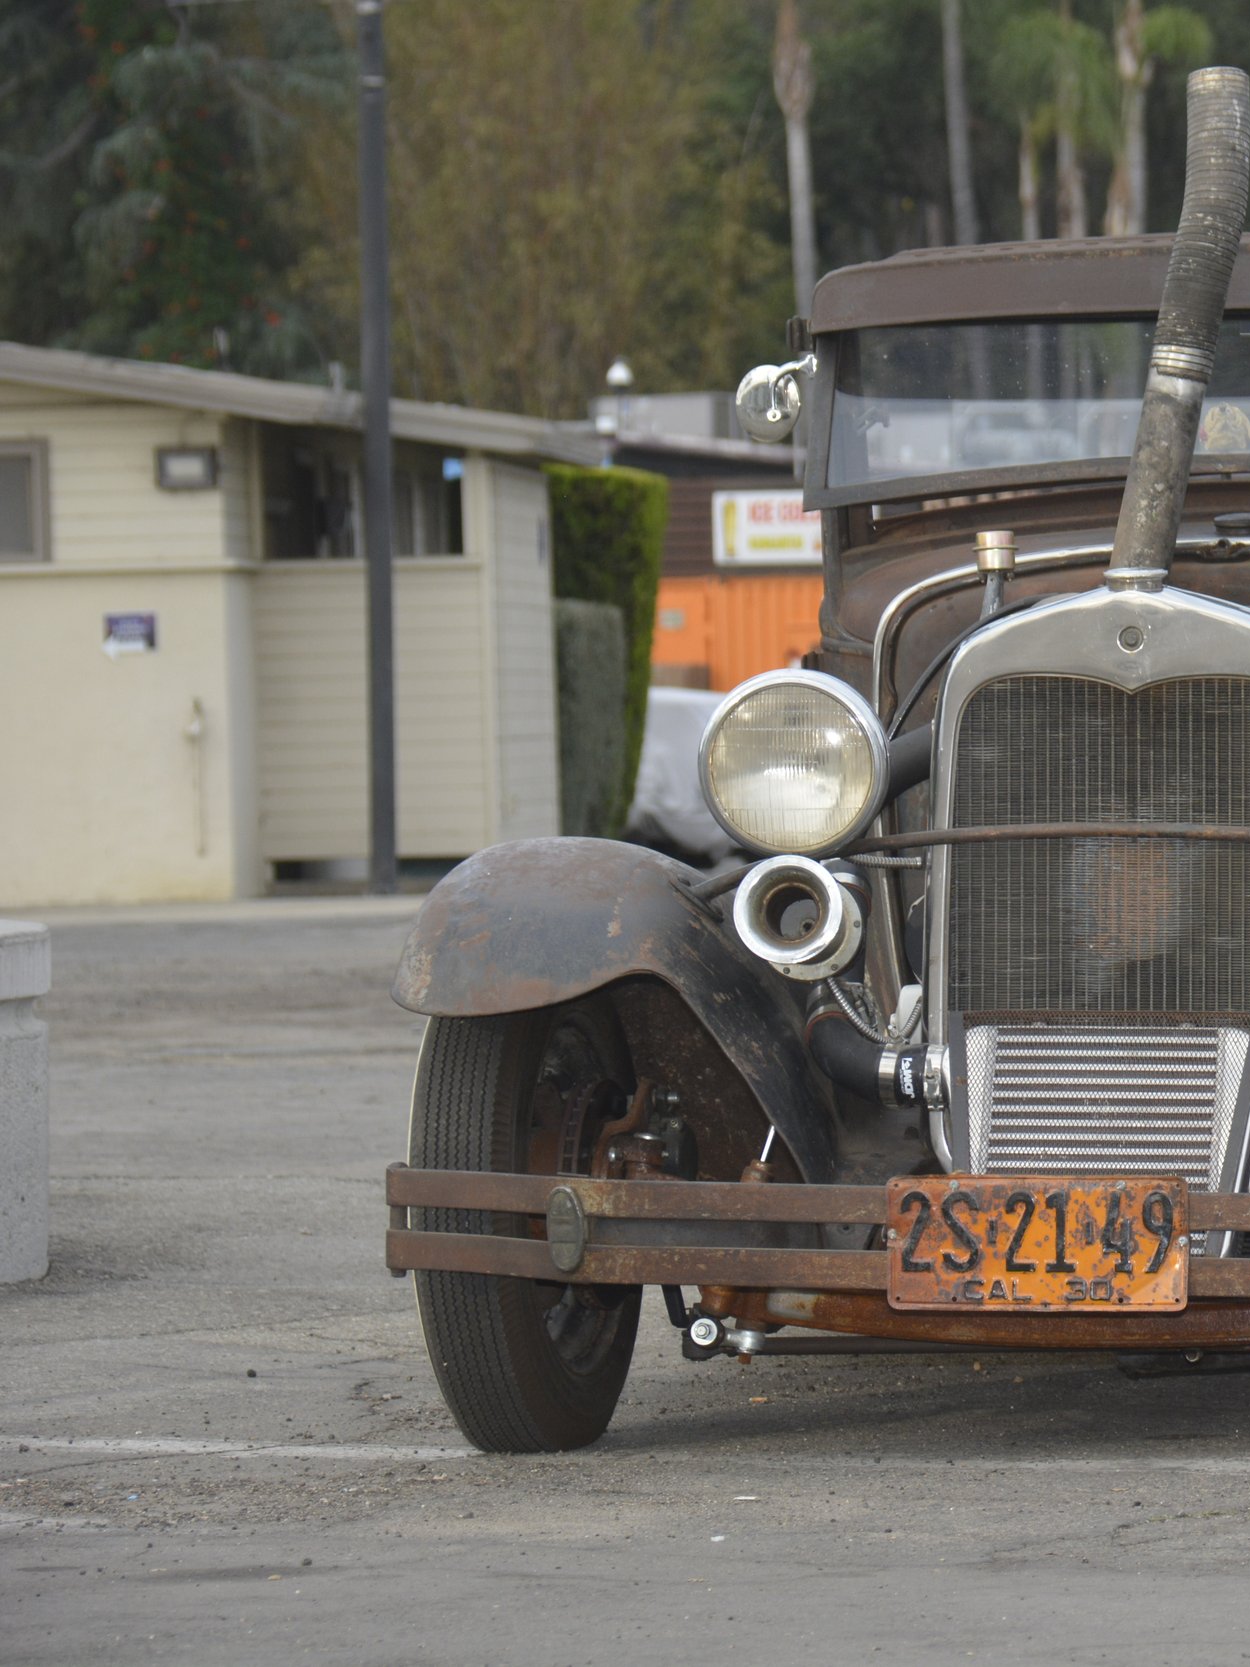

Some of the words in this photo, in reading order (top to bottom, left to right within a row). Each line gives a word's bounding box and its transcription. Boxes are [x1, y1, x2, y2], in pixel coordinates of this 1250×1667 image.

[749, 501, 773, 524] ICE
[964, 1280, 1032, 1300] CAL
[1065, 1280, 1113, 1300] 30
